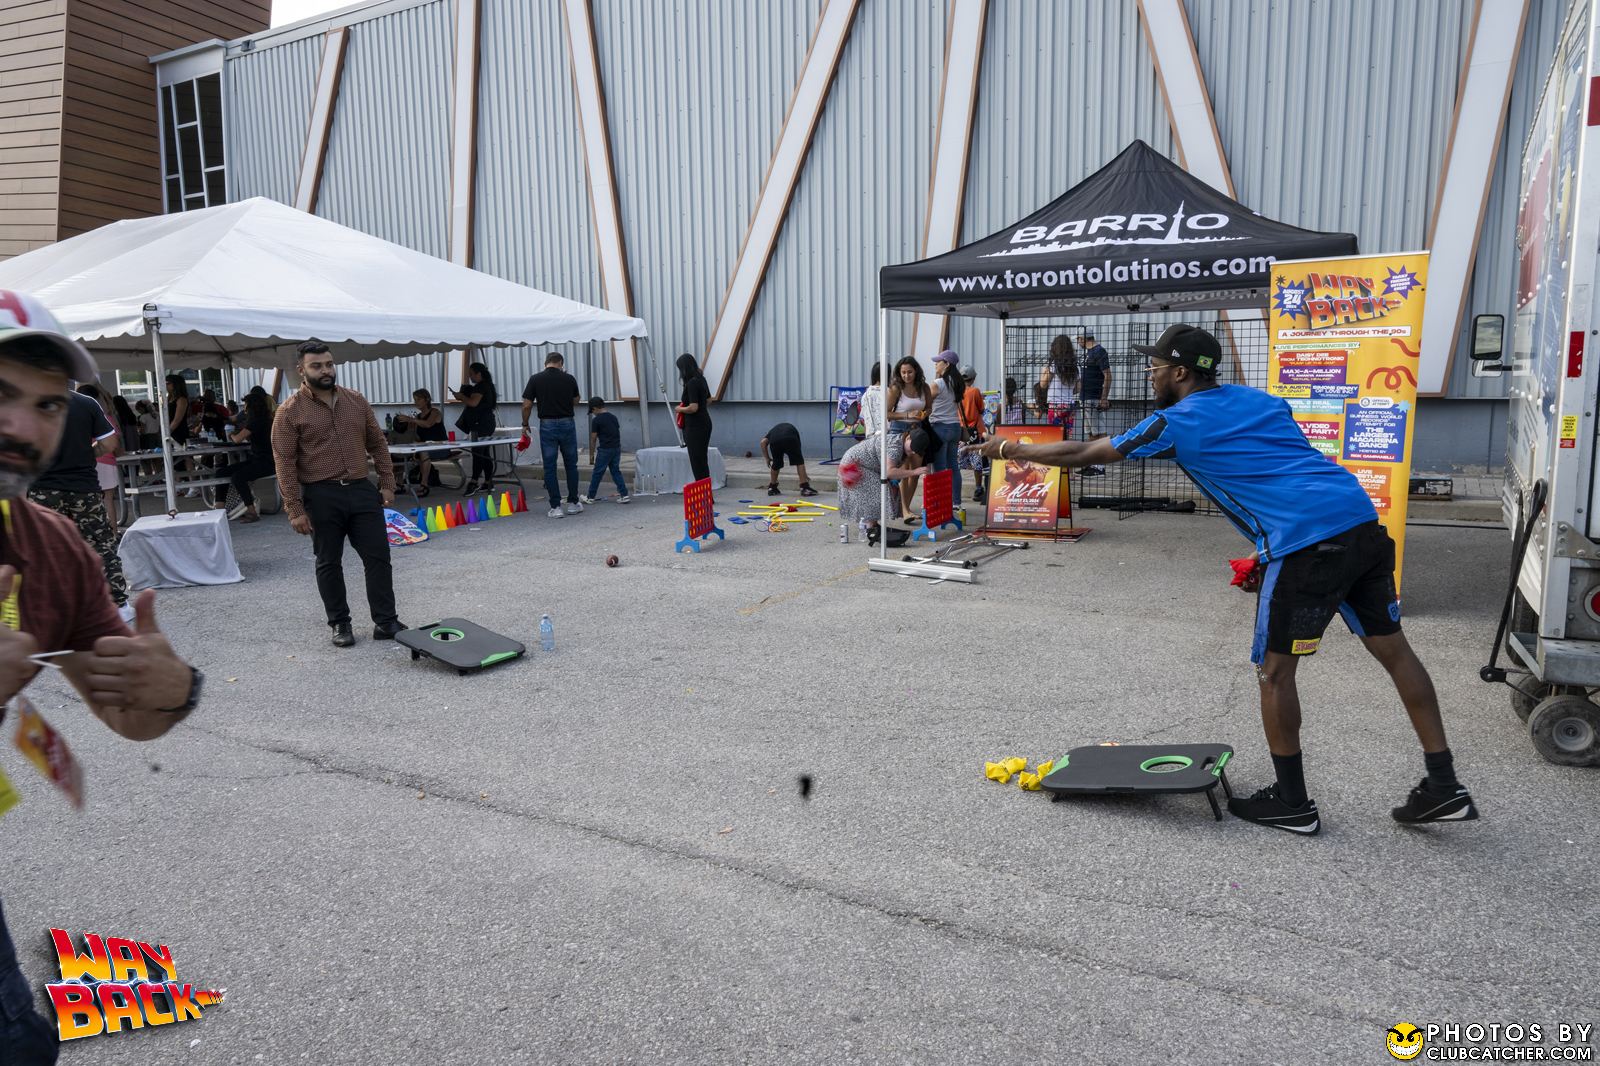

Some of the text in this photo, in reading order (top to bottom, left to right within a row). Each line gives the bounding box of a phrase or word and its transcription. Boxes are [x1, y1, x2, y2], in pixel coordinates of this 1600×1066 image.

[1009, 201, 1230, 244] BARRIO
[938, 254, 1278, 293] www.torontolatinos.com
[1307, 272, 1377, 299] WAY
[1283, 294, 1301, 305] 24
[1305, 296, 1391, 330] BACK
[1349, 436, 1399, 444] MACARENA
